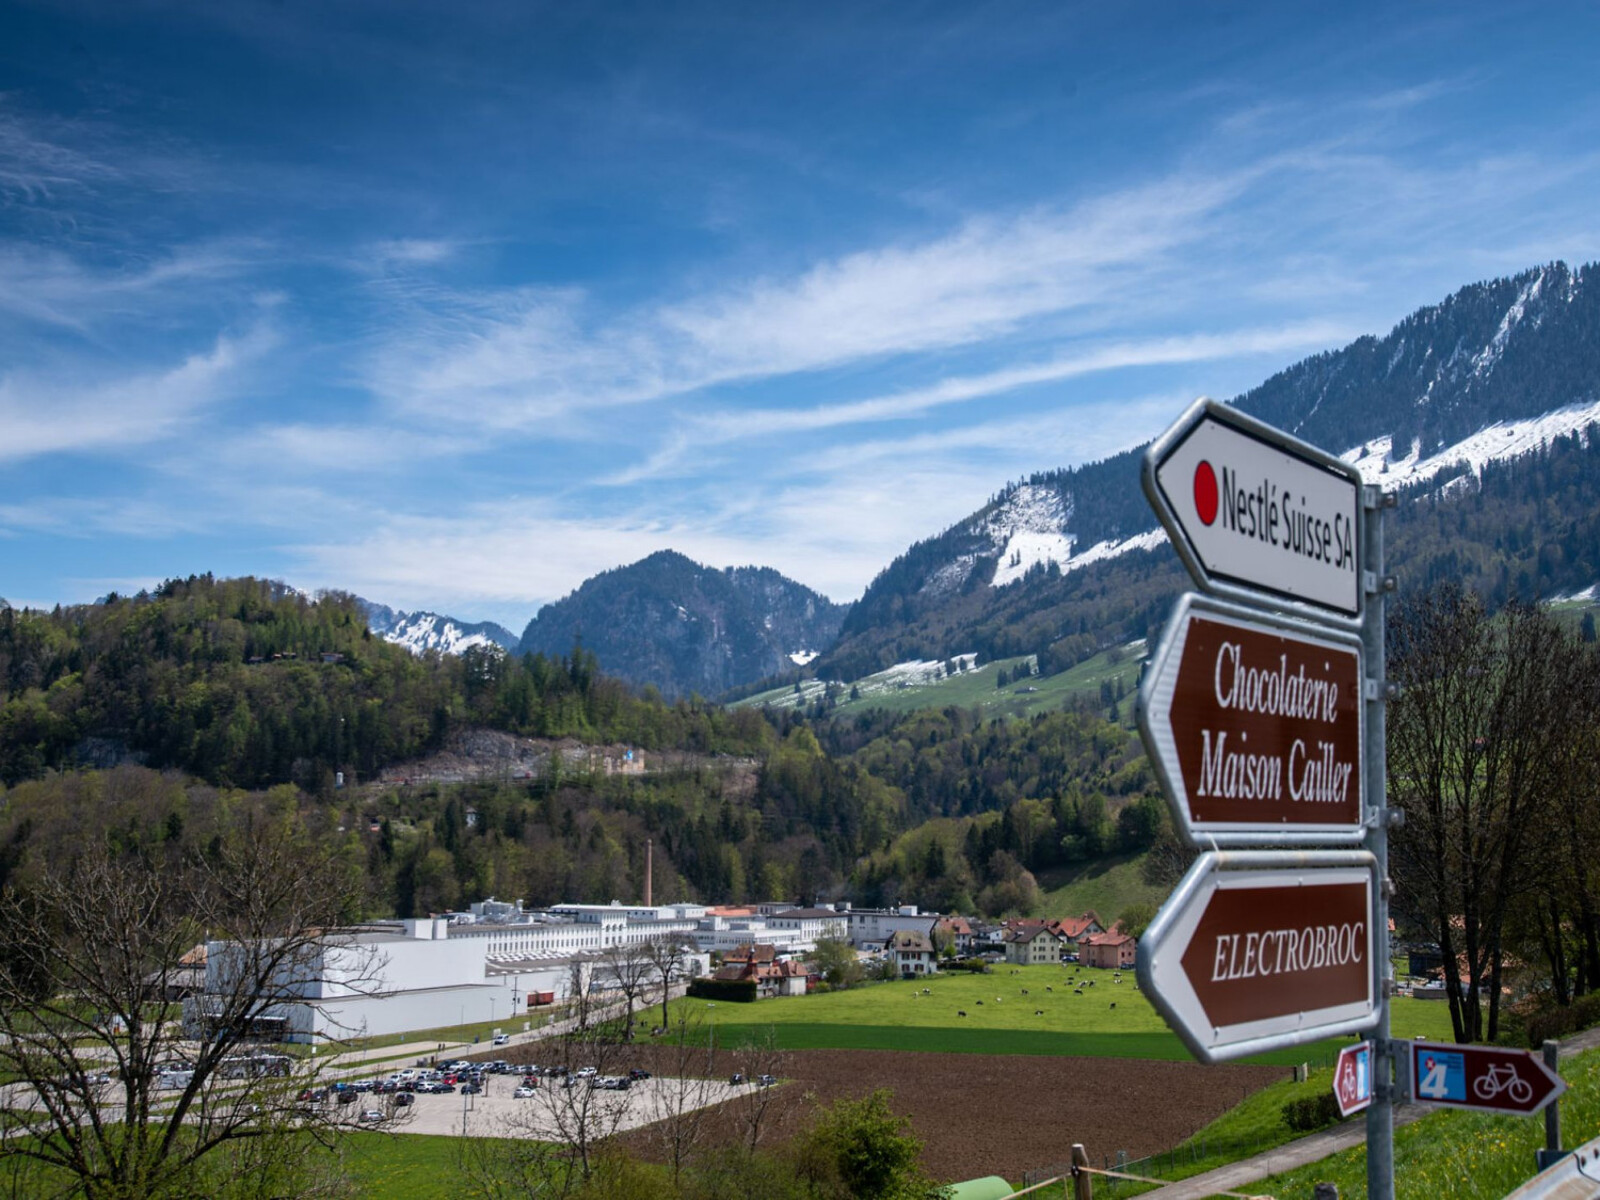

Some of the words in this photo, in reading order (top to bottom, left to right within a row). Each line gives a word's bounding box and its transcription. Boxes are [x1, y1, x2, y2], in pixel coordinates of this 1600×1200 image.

[1222, 466, 1278, 545] Nestlé
[1282, 491, 1331, 564] Suisse
[1335, 512, 1354, 572] SA
[1214, 641, 1338, 723] Chocolaterie
[1197, 729, 1282, 800] Maison
[1288, 739, 1352, 802] Cailler
[1211, 922, 1363, 982] ELECTROBROC
[1419, 1064, 1448, 1099] 4
